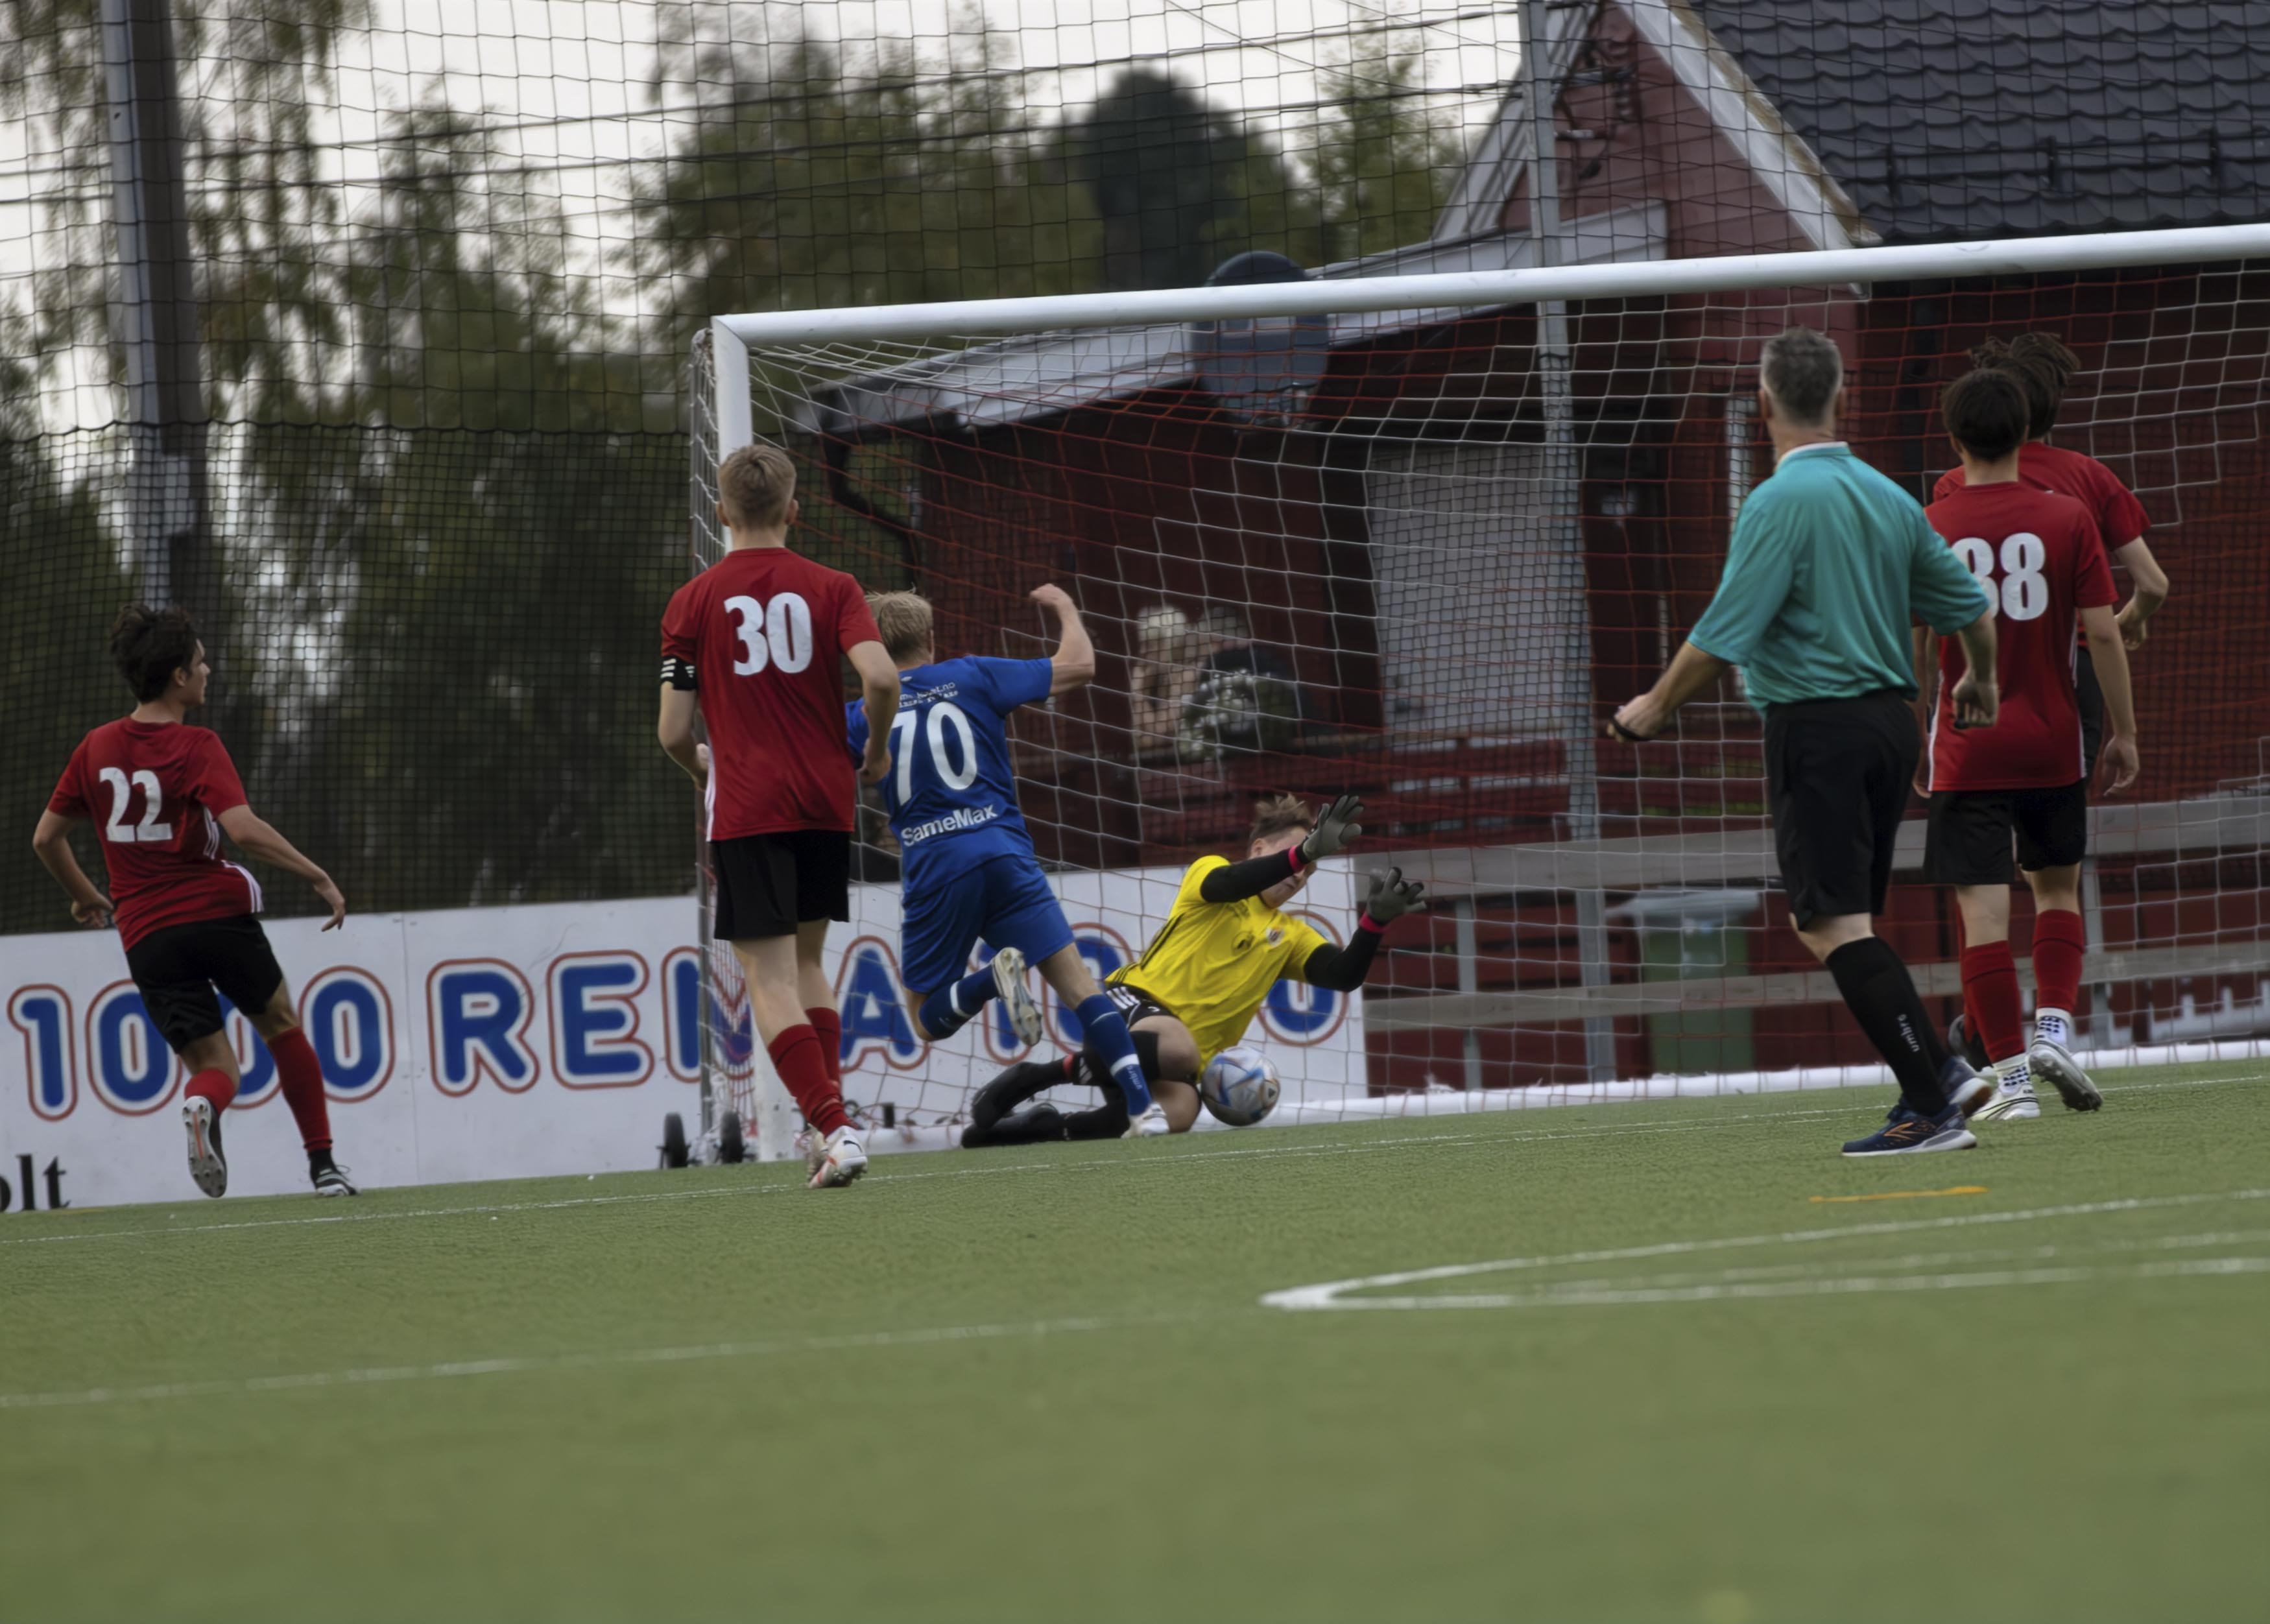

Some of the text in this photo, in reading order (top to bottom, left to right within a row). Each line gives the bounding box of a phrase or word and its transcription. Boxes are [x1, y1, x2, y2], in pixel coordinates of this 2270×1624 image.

[1948, 532, 2049, 621] 88
[724, 592, 813, 676] 30
[890, 701, 977, 807] 70
[99, 767, 173, 842] 22
[901, 804, 998, 846] SameMax
[1896, 1014, 1920, 1052] umbro
